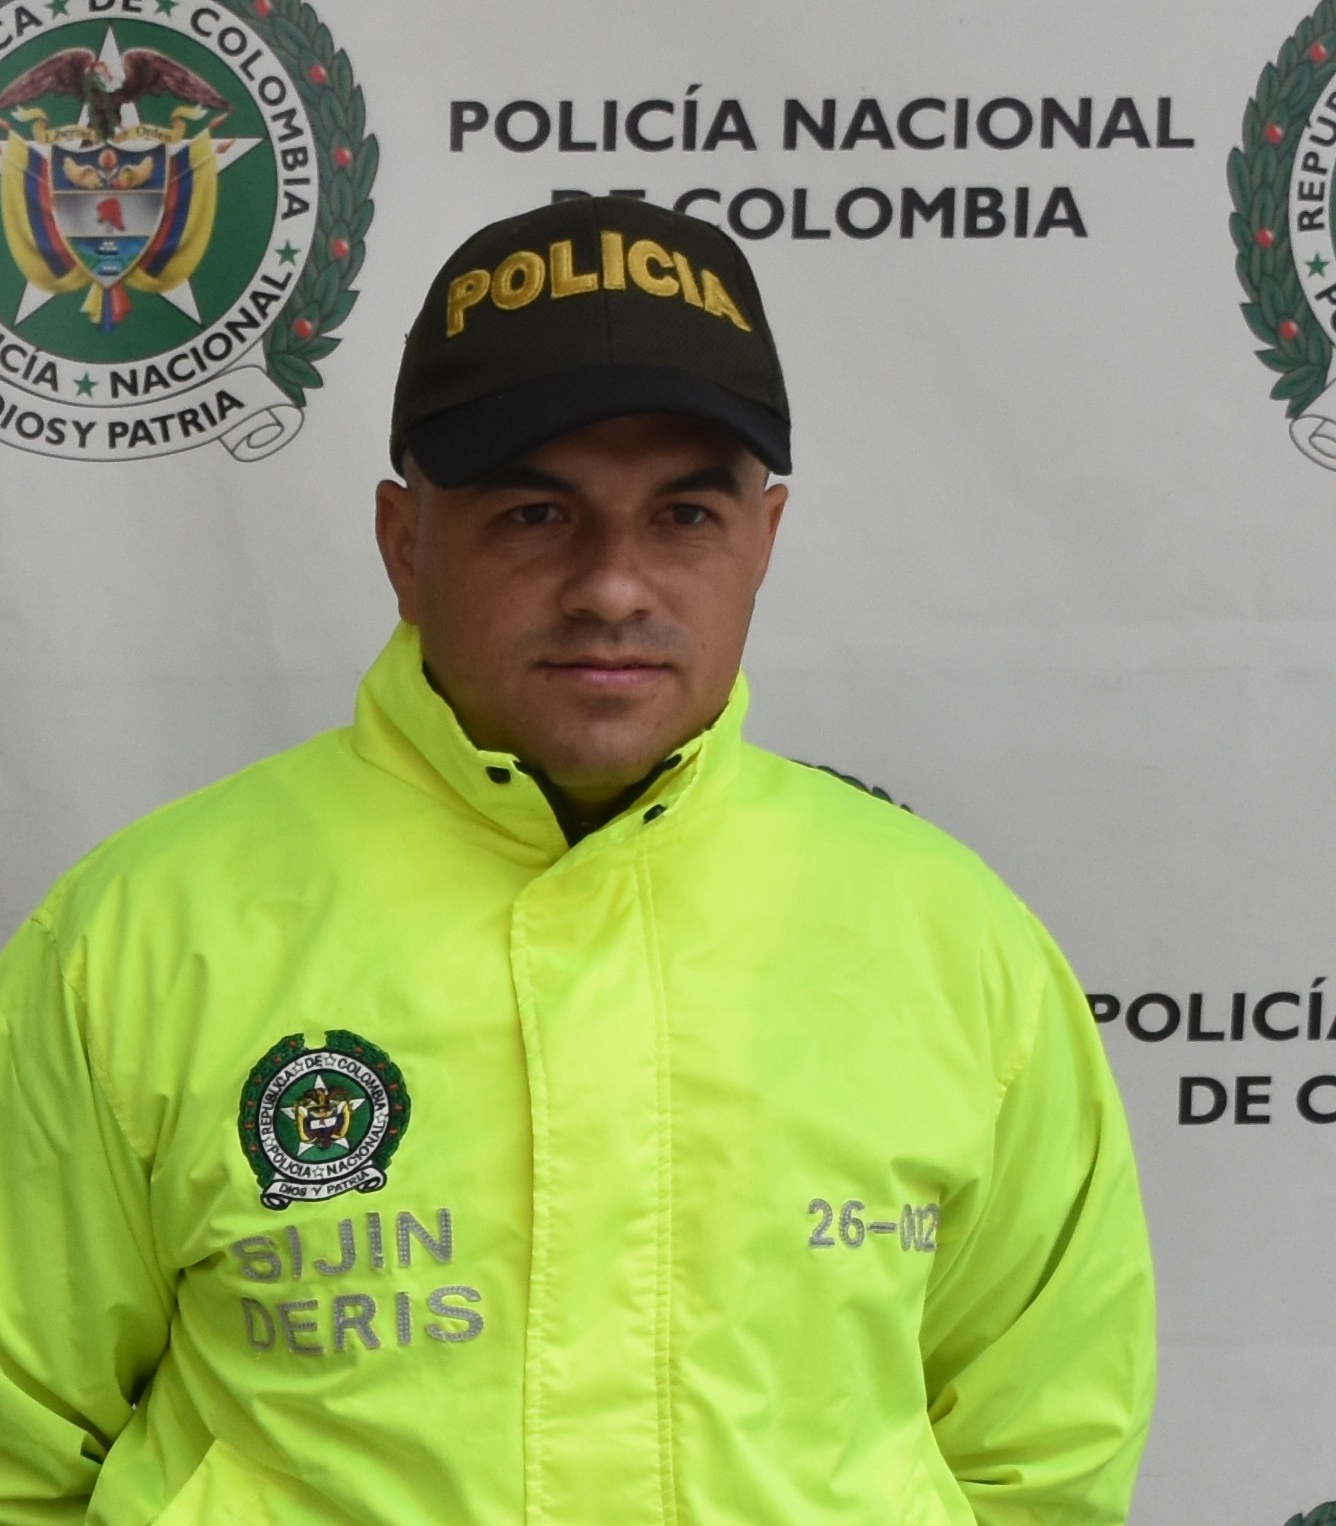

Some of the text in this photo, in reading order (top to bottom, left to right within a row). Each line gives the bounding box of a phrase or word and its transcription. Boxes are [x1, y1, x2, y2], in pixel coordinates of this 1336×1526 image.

[190, 8, 311, 220] COLOMBIA
[449, 84, 1195, 154] POLICÍA NACIONAL
[446, 230, 753, 339] POLICIA
[109, 272, 292, 400] NACIONAL
[109, 389, 245, 450] PATRIA
[1086, 977, 1336, 1042] POLICÍ
[1179, 1076, 1271, 1125] DE
[231, 1208, 454, 1282] SIJIN
[240, 1285, 484, 1356] DERIS
